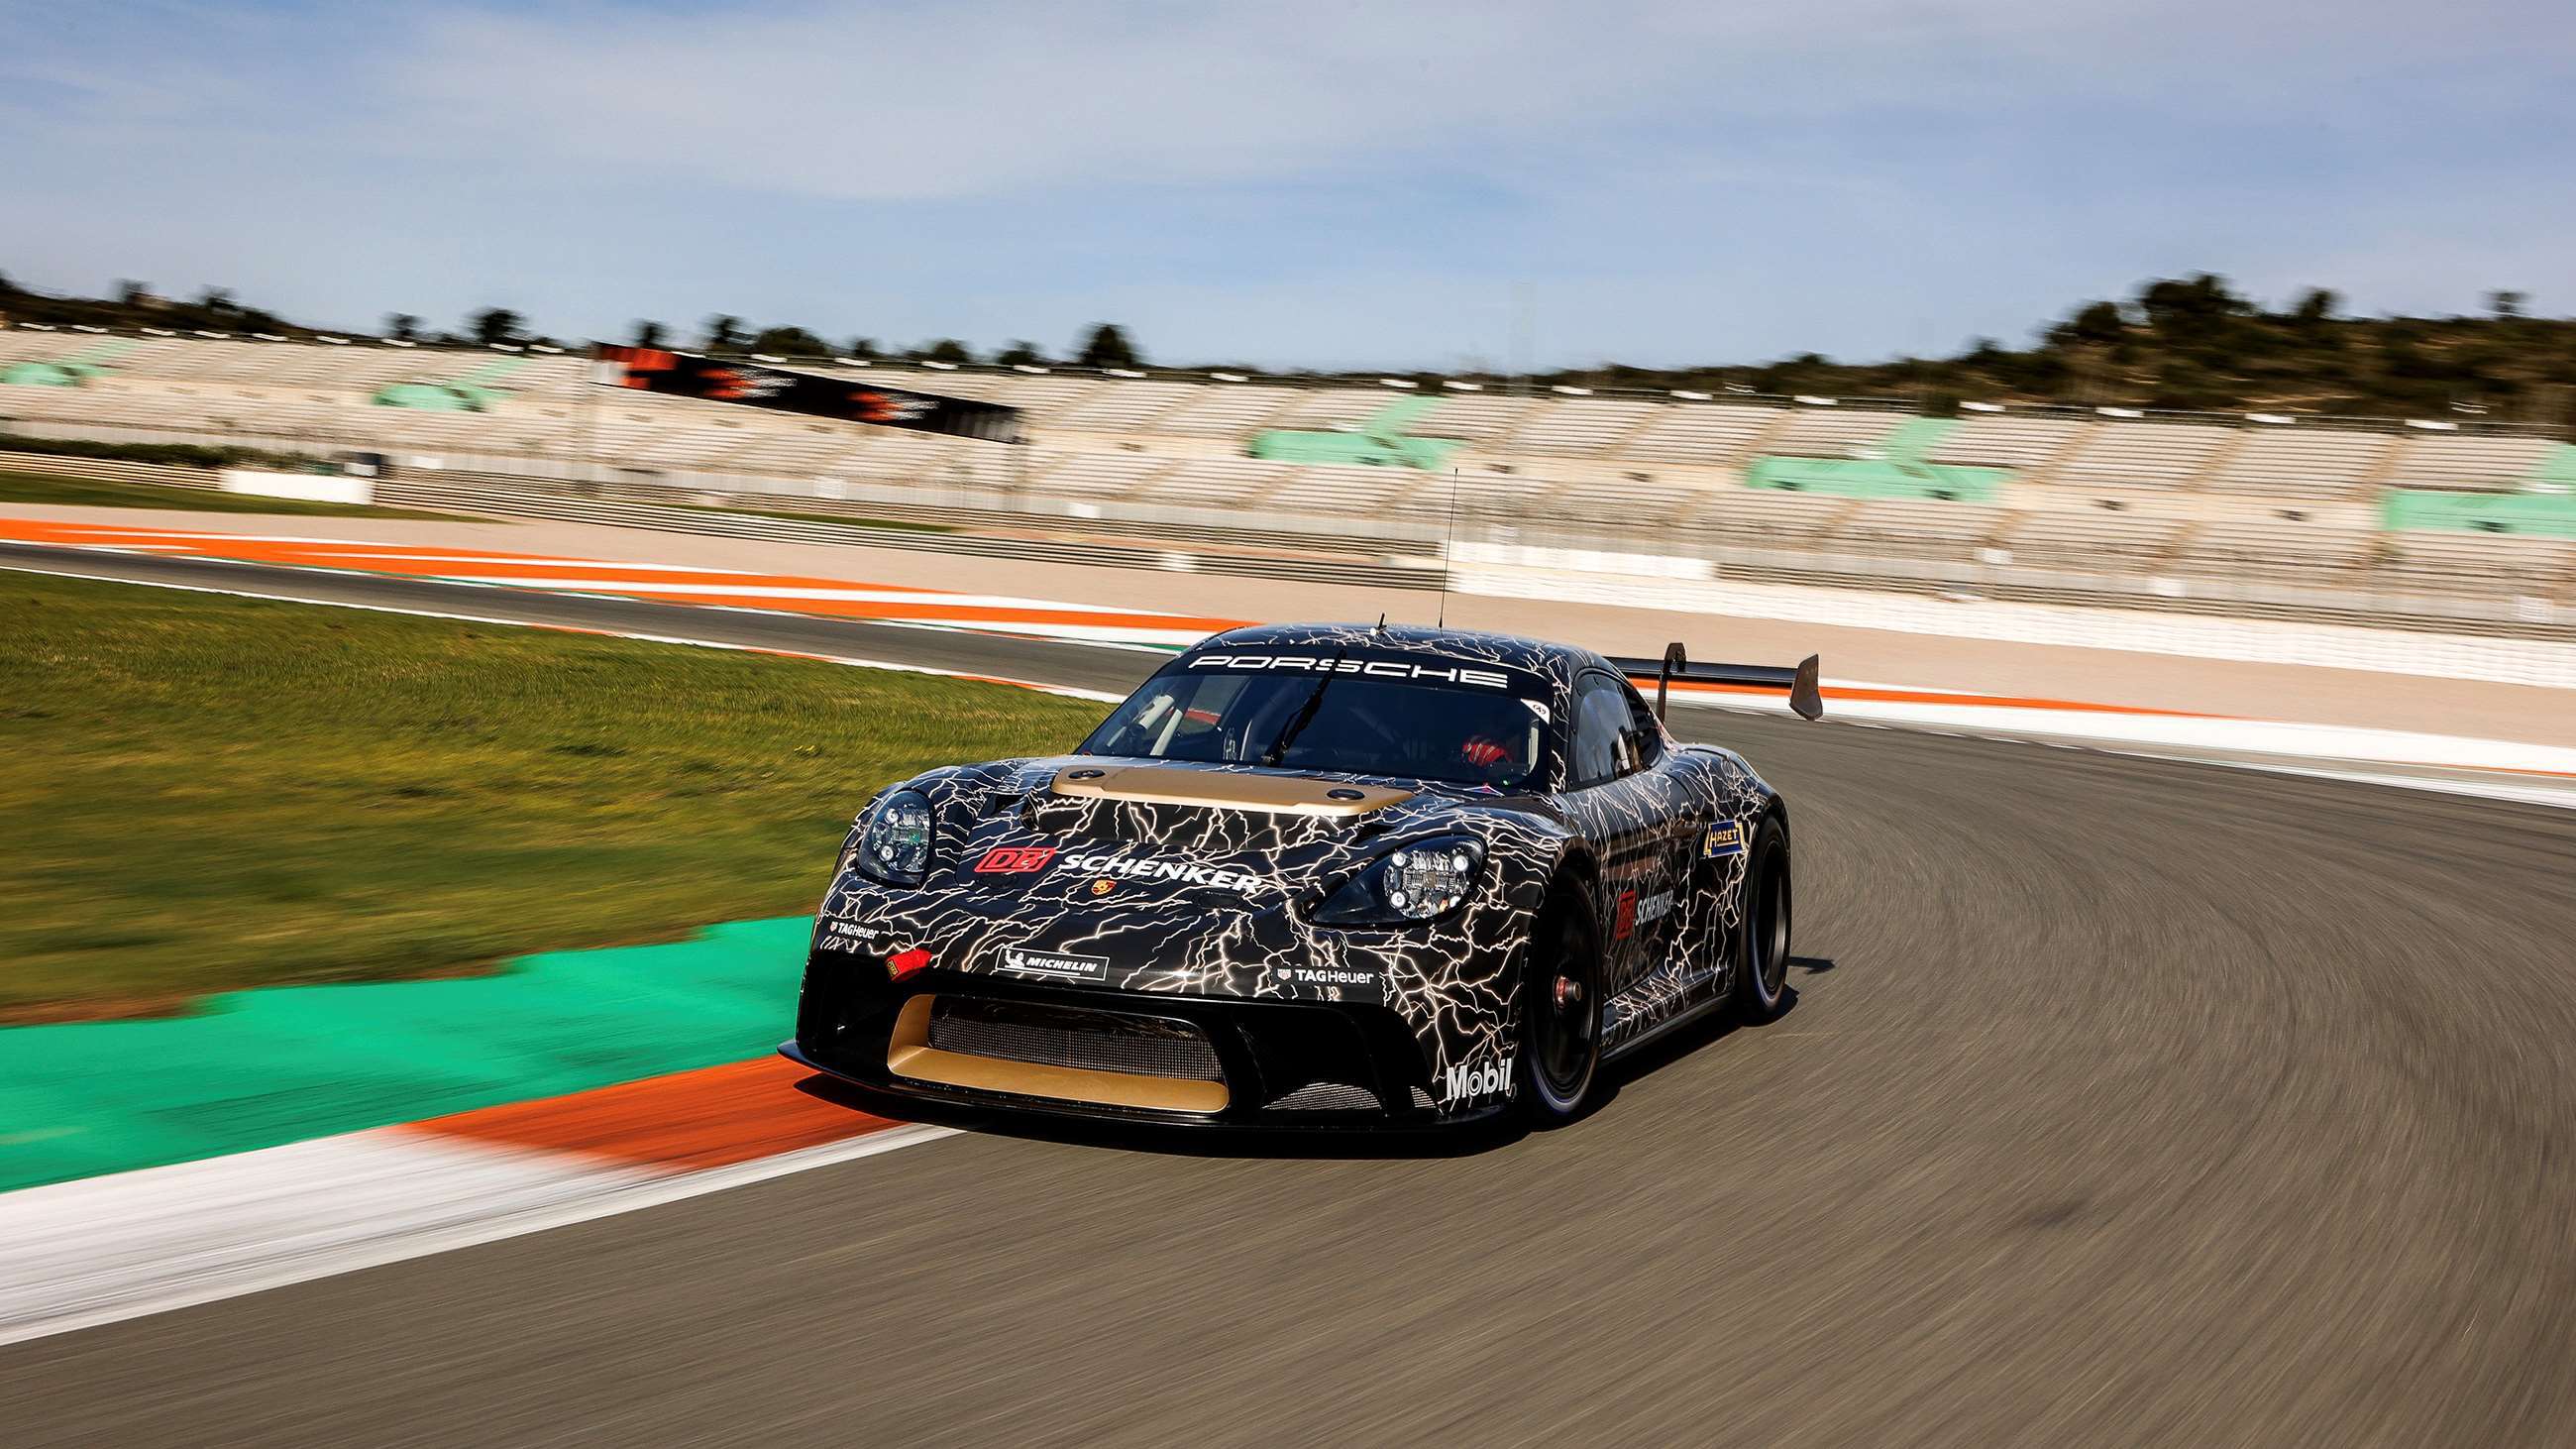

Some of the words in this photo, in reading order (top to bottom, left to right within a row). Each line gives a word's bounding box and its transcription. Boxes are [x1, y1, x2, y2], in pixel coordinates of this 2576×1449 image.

[1189, 655, 1509, 689] PORSCHE
[1710, 829, 1739, 847] HAZET
[983, 849, 1046, 869] DB
[1058, 854, 1263, 893] SCHENKER
[1026, 956, 1098, 972] MICHELIN
[1447, 1058, 1512, 1101] Mobil
